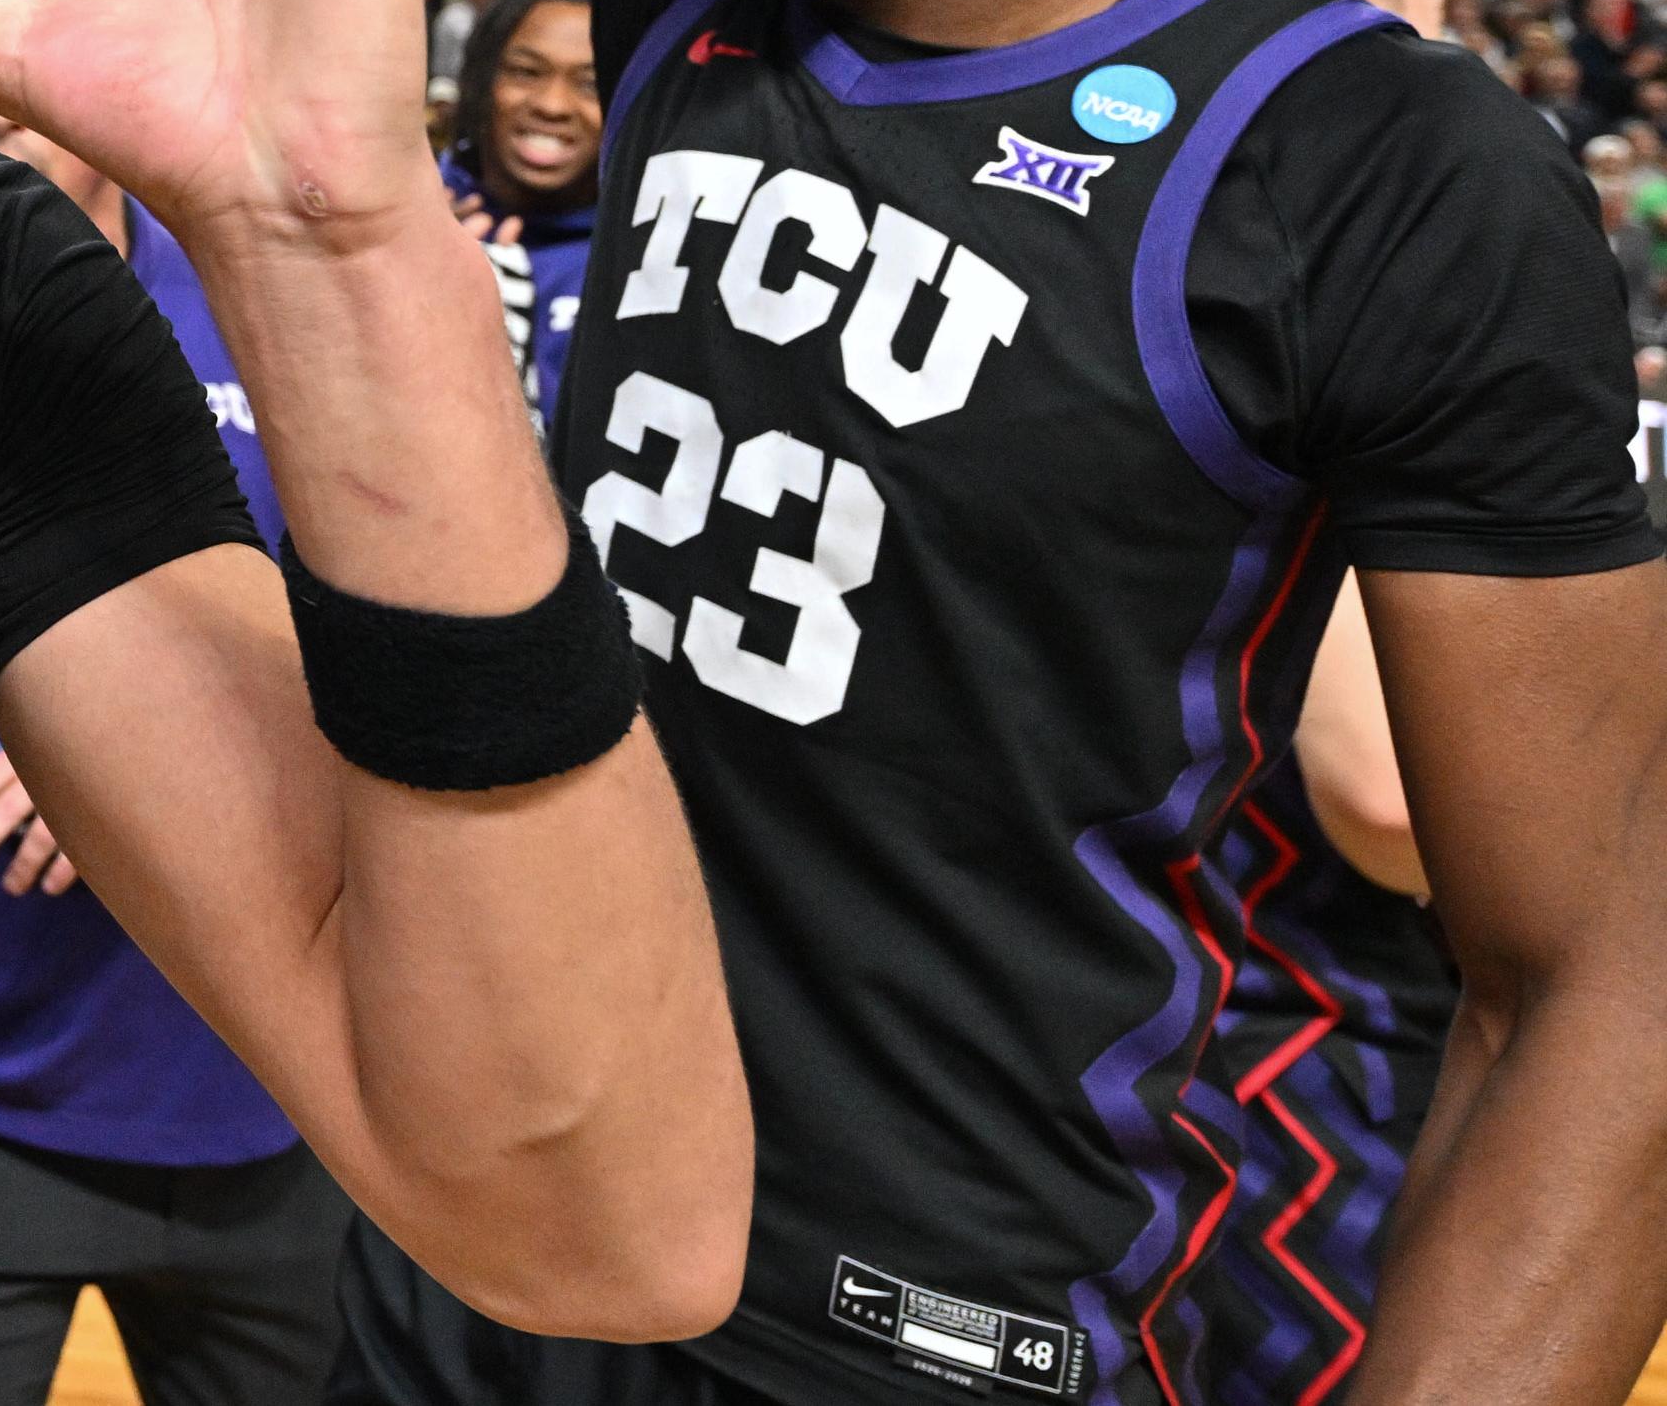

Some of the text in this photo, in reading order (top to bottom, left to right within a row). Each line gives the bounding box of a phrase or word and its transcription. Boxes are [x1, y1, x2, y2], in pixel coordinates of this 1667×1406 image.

[1081, 91, 1161, 133] NCAA
[987, 137, 1100, 206] XII
[616, 149, 1029, 428] TCU
[581, 370, 886, 727] 23
[1013, 1337, 1055, 1371] 48
